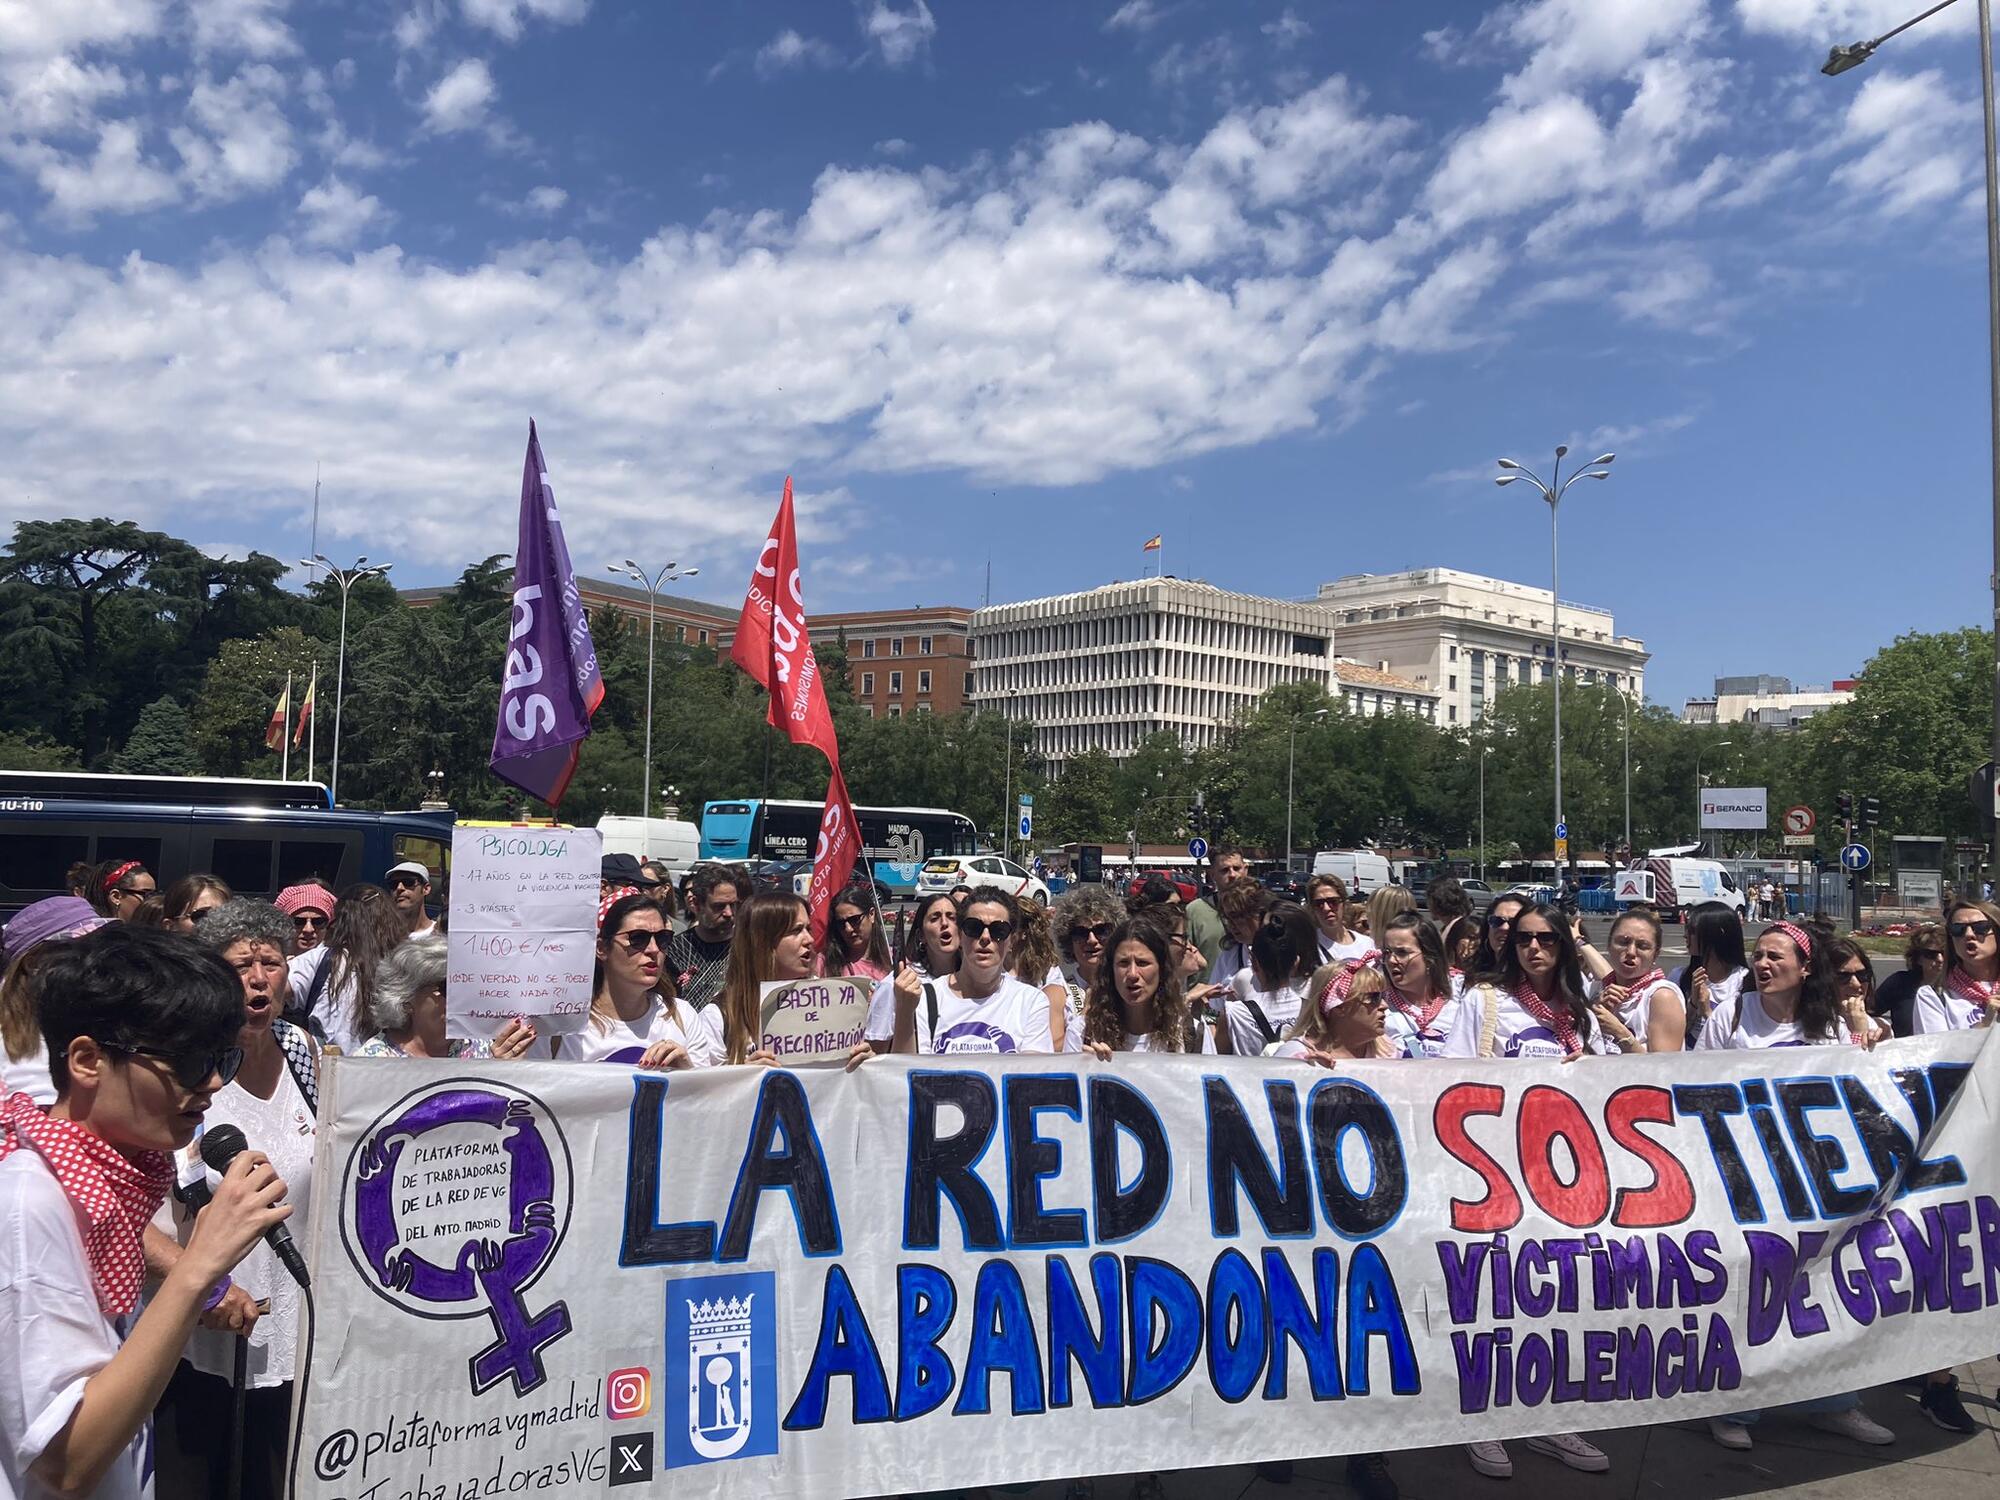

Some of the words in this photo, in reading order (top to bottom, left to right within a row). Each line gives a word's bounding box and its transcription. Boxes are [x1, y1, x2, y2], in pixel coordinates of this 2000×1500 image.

[888, 824, 910, 835] MADRID
[765, 833, 787, 846] LÍNEA
[787, 836, 807, 847] CERO
[486, 870, 511, 881] AÑOS
[520, 872, 532, 880] EN
[539, 872, 549, 881] LA
[554, 872, 574, 880] RED
[517, 884, 528, 893] LA
[532, 883, 570, 893] VIOLENCIA
[480, 902, 516, 913] MÁSTER
[480, 973, 521, 984] VERDAD
[527, 974, 539, 983] NO
[545, 975, 559, 983] SE
[563, 972, 589, 983] PUEDE
[479, 990, 511, 998] HACER
[520, 990, 549, 998] NADA
[777, 985, 830, 1010] BASTA
[840, 985, 855, 1005] YA
[805, 1011, 819, 1022] DE
[951, 1042, 993, 1052] PLATAFORMA
[414, 1143, 500, 1166] PLATAFORMA
[402, 1173, 418, 1189] DE
[424, 1162, 507, 1185] TRABAJADORAS
[618, 1069, 843, 1268] LA
[901, 1069, 1173, 1252] RED
[1201, 1073, 1408, 1242] NO
[402, 1196, 420, 1216] DE
[426, 1191, 443, 1208] LA
[448, 1189, 470, 1204] RED
[474, 1186, 489, 1200] DE
[491, 1186, 507, 1198] VG
[406, 1225, 428, 1242] DEL
[1744, 1229, 1831, 1348] DE
[783, 1242, 1422, 1432] ABANDONA
[314, 1378, 602, 1483] @plataformavgmadrid
